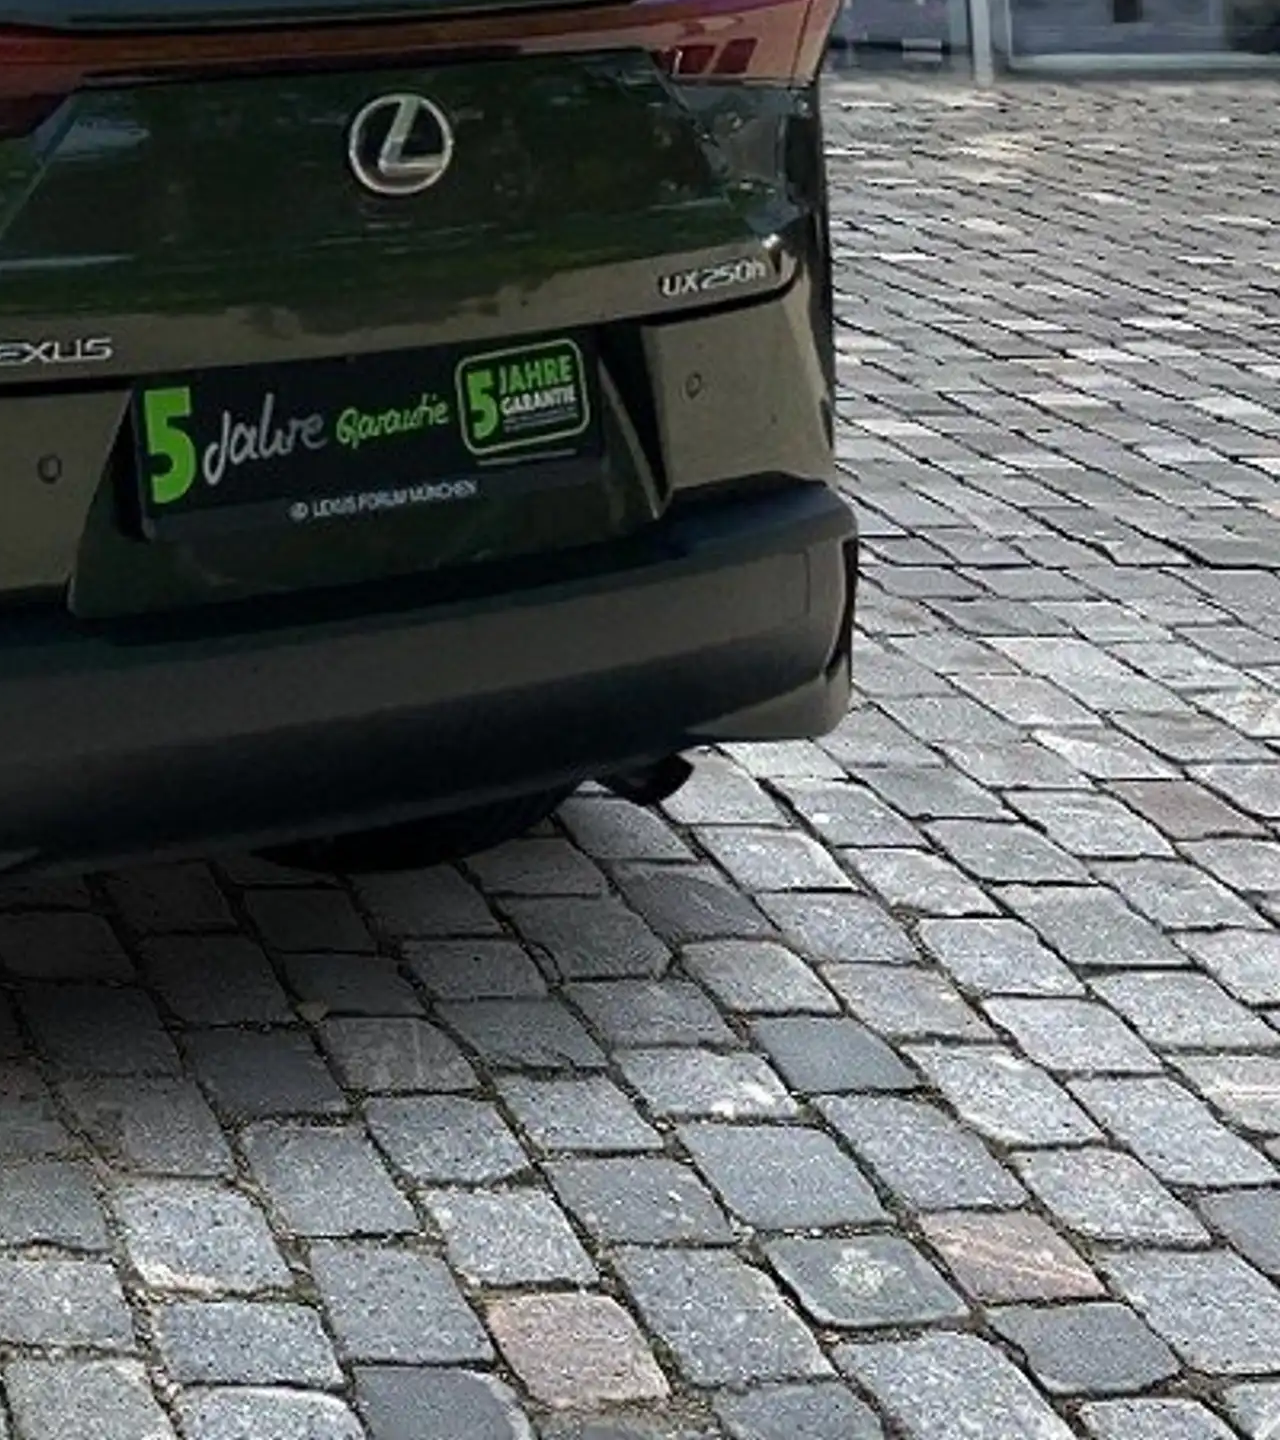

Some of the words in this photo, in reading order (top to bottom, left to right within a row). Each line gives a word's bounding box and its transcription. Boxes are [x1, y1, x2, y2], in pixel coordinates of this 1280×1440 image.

[662, 259, 766, 296] UX250h
[466, 369, 499, 440] 5
[499, 354, 573, 396] JAHRE
[499, 383, 577, 416] GARANTIE
[144, 386, 196, 504] 5
[202, 392, 328, 485] Jahre
[336, 393, 449, 449] Garantie
